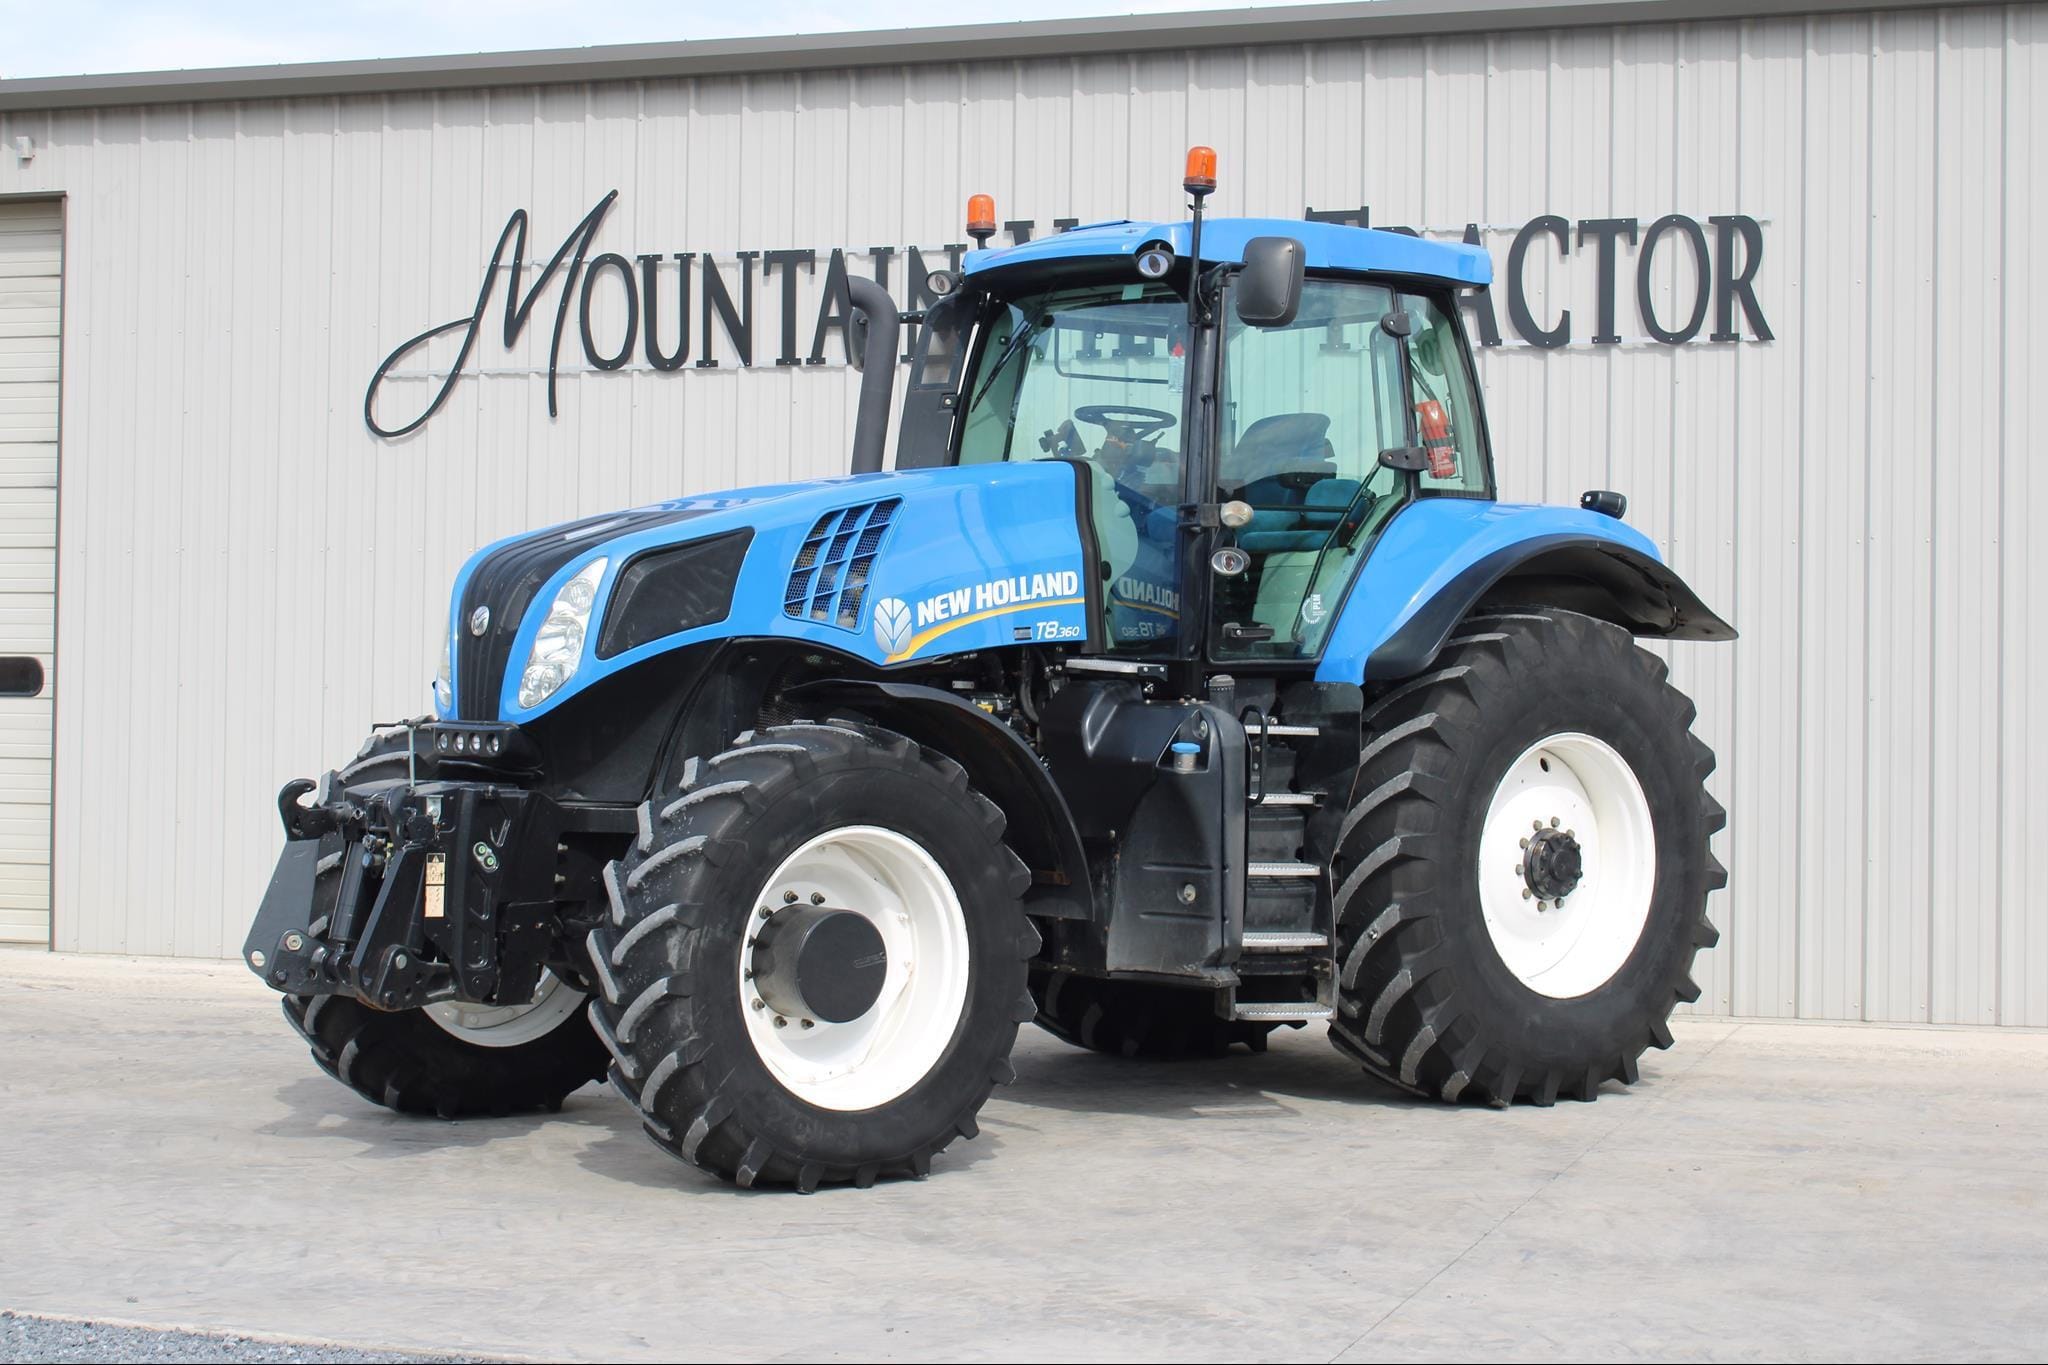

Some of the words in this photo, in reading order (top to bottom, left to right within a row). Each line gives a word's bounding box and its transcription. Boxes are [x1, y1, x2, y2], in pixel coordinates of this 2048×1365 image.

[1303, 205, 1775, 349] ACTOR
[917, 587, 972, 628] NEW
[976, 571, 1078, 609] HOLLAND
